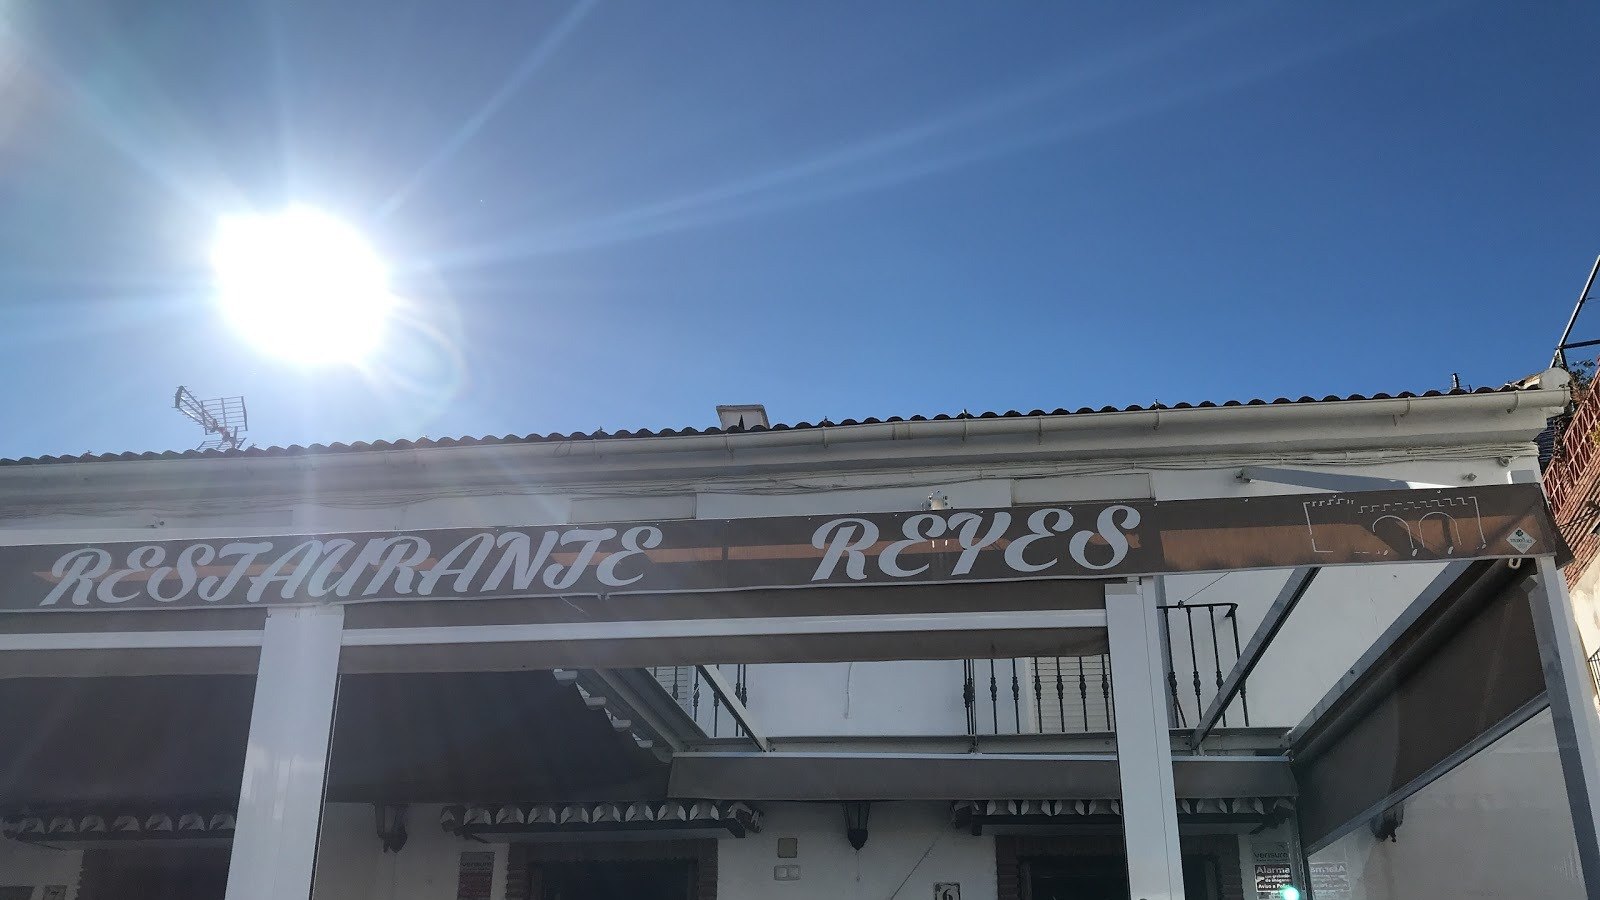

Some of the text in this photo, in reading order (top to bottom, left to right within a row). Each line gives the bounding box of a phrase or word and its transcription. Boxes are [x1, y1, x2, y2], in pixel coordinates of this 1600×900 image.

[39, 505, 1141, 606] RESTAURANTE REYES
[1256, 866, 1290, 874] Alarma
